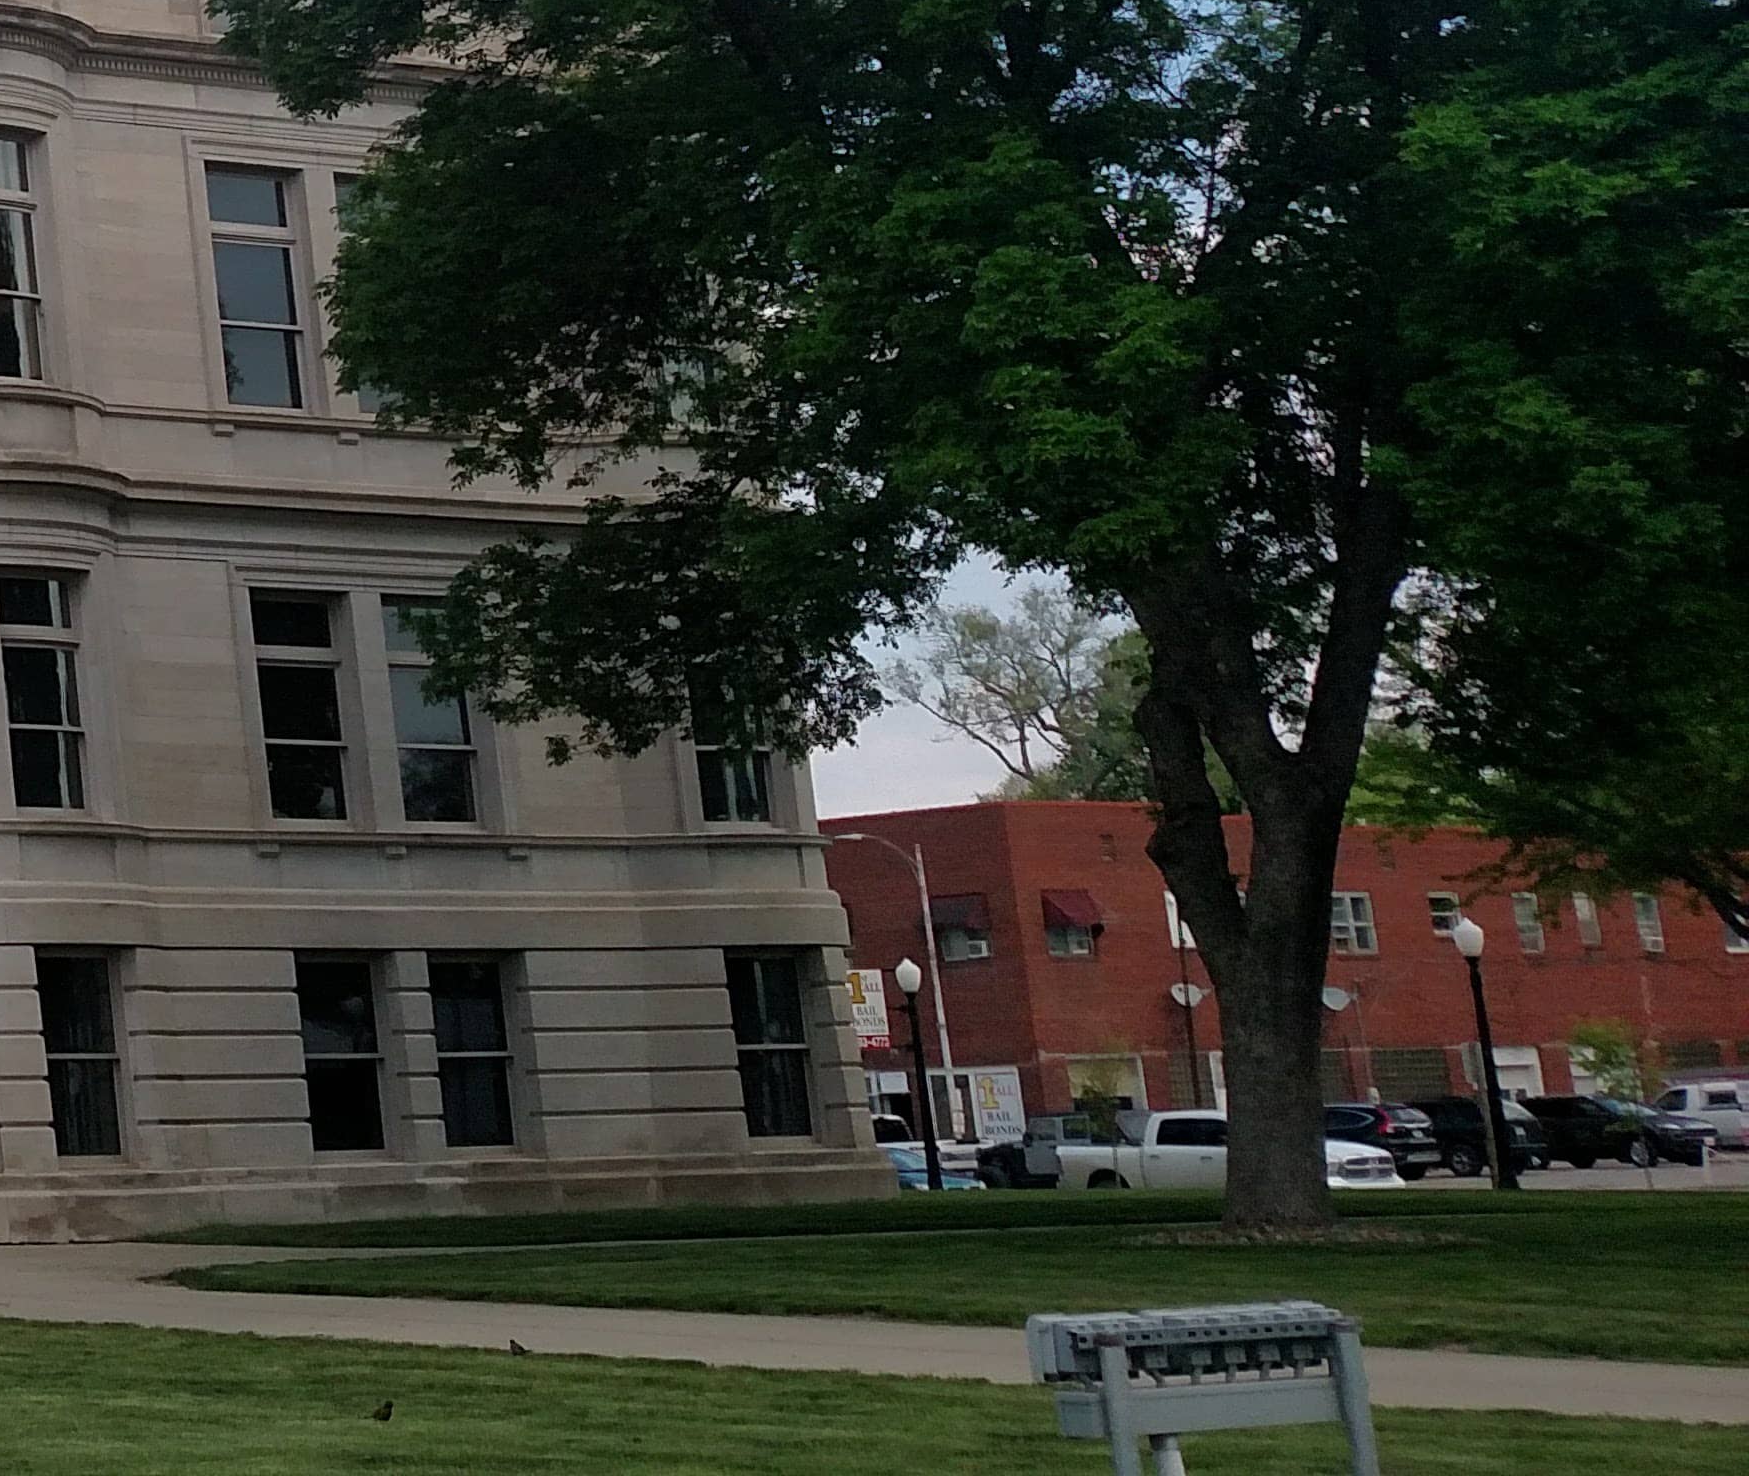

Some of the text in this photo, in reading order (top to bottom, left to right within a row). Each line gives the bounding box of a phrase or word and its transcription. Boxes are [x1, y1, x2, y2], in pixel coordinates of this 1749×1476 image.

[856, 1006, 878, 1016] BAIL
[986, 1112, 1012, 1122] BAIL
[984, 1125, 1022, 1135] BONDS
